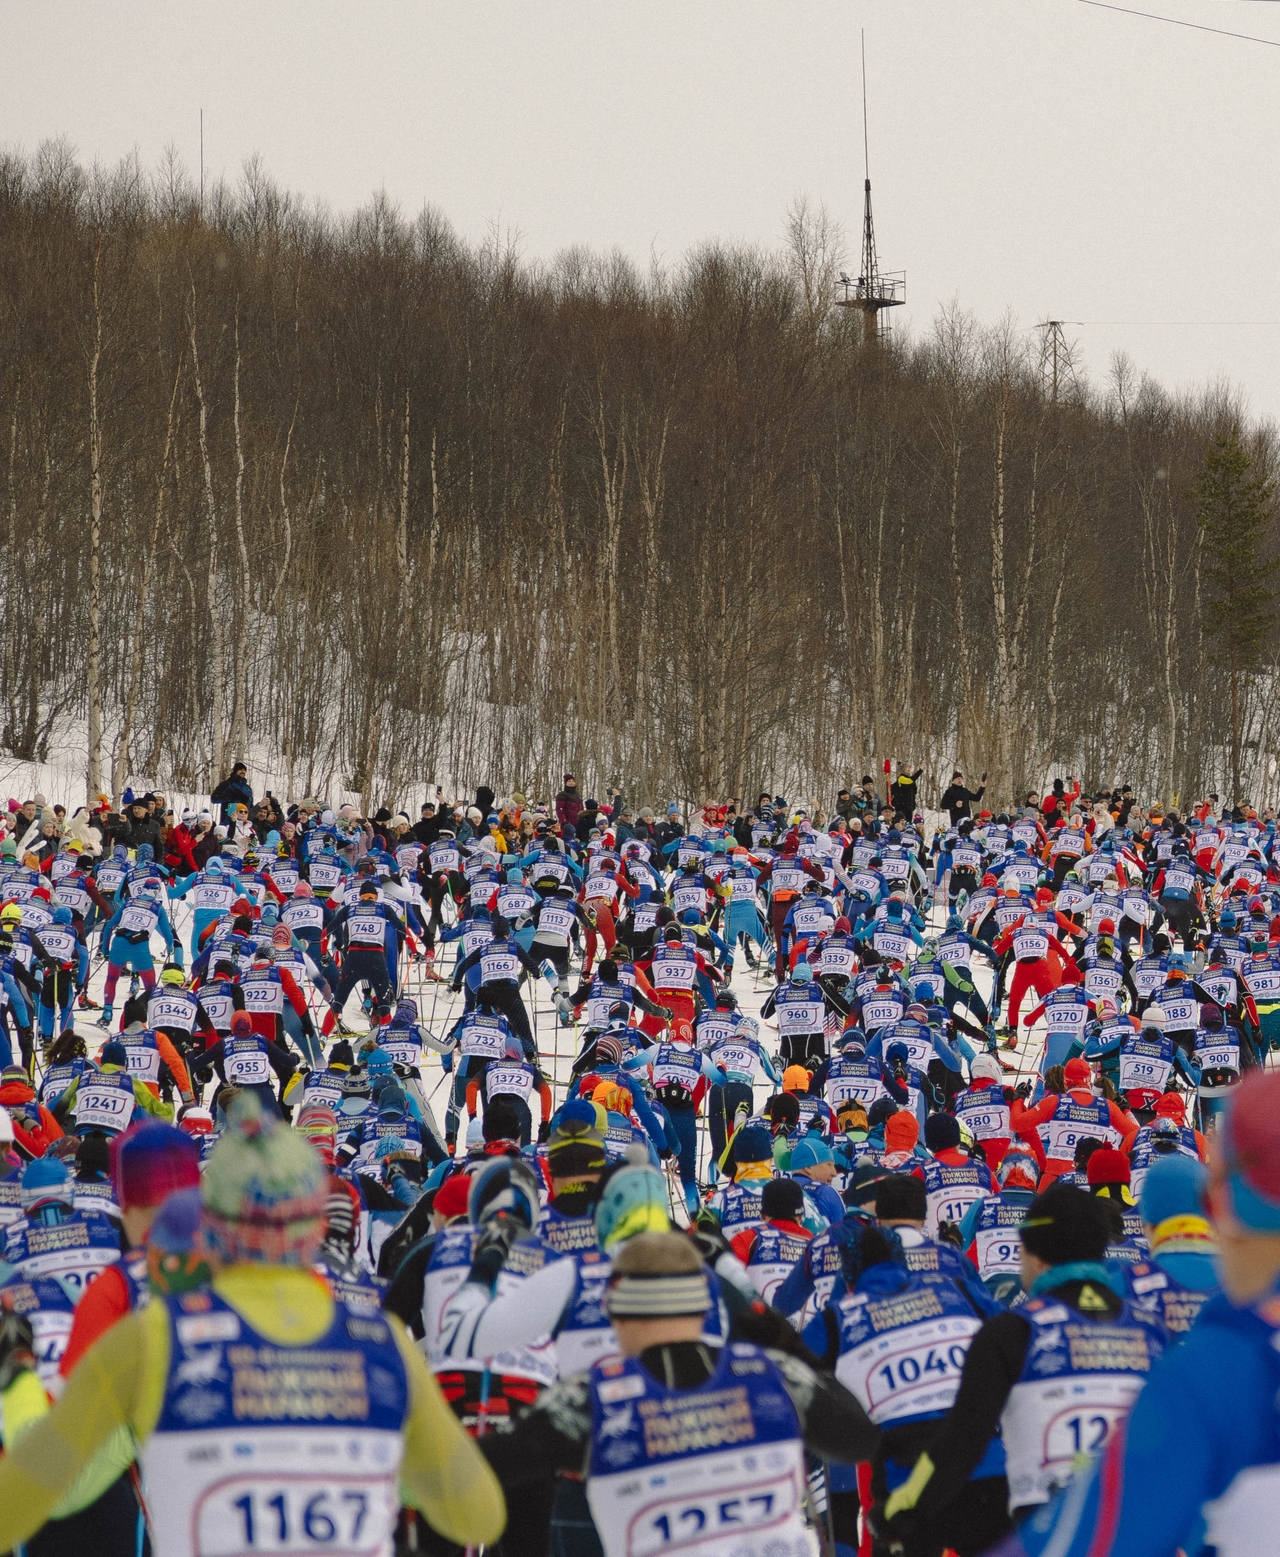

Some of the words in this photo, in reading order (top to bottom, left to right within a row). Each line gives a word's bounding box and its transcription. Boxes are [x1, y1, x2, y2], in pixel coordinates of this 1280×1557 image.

[60, 894, 72, 902] 771
[23, 913, 41, 921] 766
[291, 911, 310, 919] 792
[547, 915, 563, 923] 1113
[882, 941, 901, 951] 1023
[488, 962, 509, 970] 1166
[666, 968, 685, 977] 937
[1094, 976, 1114, 985] 1361
[1254, 980, 1272, 989] 981
[248, 991, 267, 999] 922
[160, 1005, 188, 1016] 1344
[870, 1009, 892, 1018] 1013
[1052, 1012, 1076, 1021] 1270
[705, 1030, 727, 1039] 1101
[476, 1035, 494, 1045] 732
[1134, 1048, 1161, 1057] МАРАФОН
[1135, 1044, 1162, 1052] ЛЫЖНЫЙ
[724, 1051, 743, 1059] 990
[1210, 1054, 1229, 1063] 900
[237, 1062, 258, 1072] 955
[1135, 1064, 1153, 1074] 519
[496, 1075, 521, 1084] 1372
[840, 1088, 868, 1099] 1177
[86, 1097, 116, 1110] 1241
[964, 1094, 990, 1104] ЛЫЖНЫЙ
[964, 1099, 990, 1108] МАРАФОН
[1070, 1108, 1099, 1117] ЛЫЖНЫЙ
[966, 1116, 990, 1127] 880
[1070, 1113, 1098, 1122] МАРАФОН
[28, 1228, 86, 1247] ЛЫЖНЫЙ
[28, 1236, 90, 1255] МАРАФОН
[872, 1295, 938, 1321] ЛЫЖНЫЙ
[874, 1305, 942, 1330] МАРАФОН
[881, 1346, 965, 1390] 1040
[232, 1490, 369, 1544] 1167
